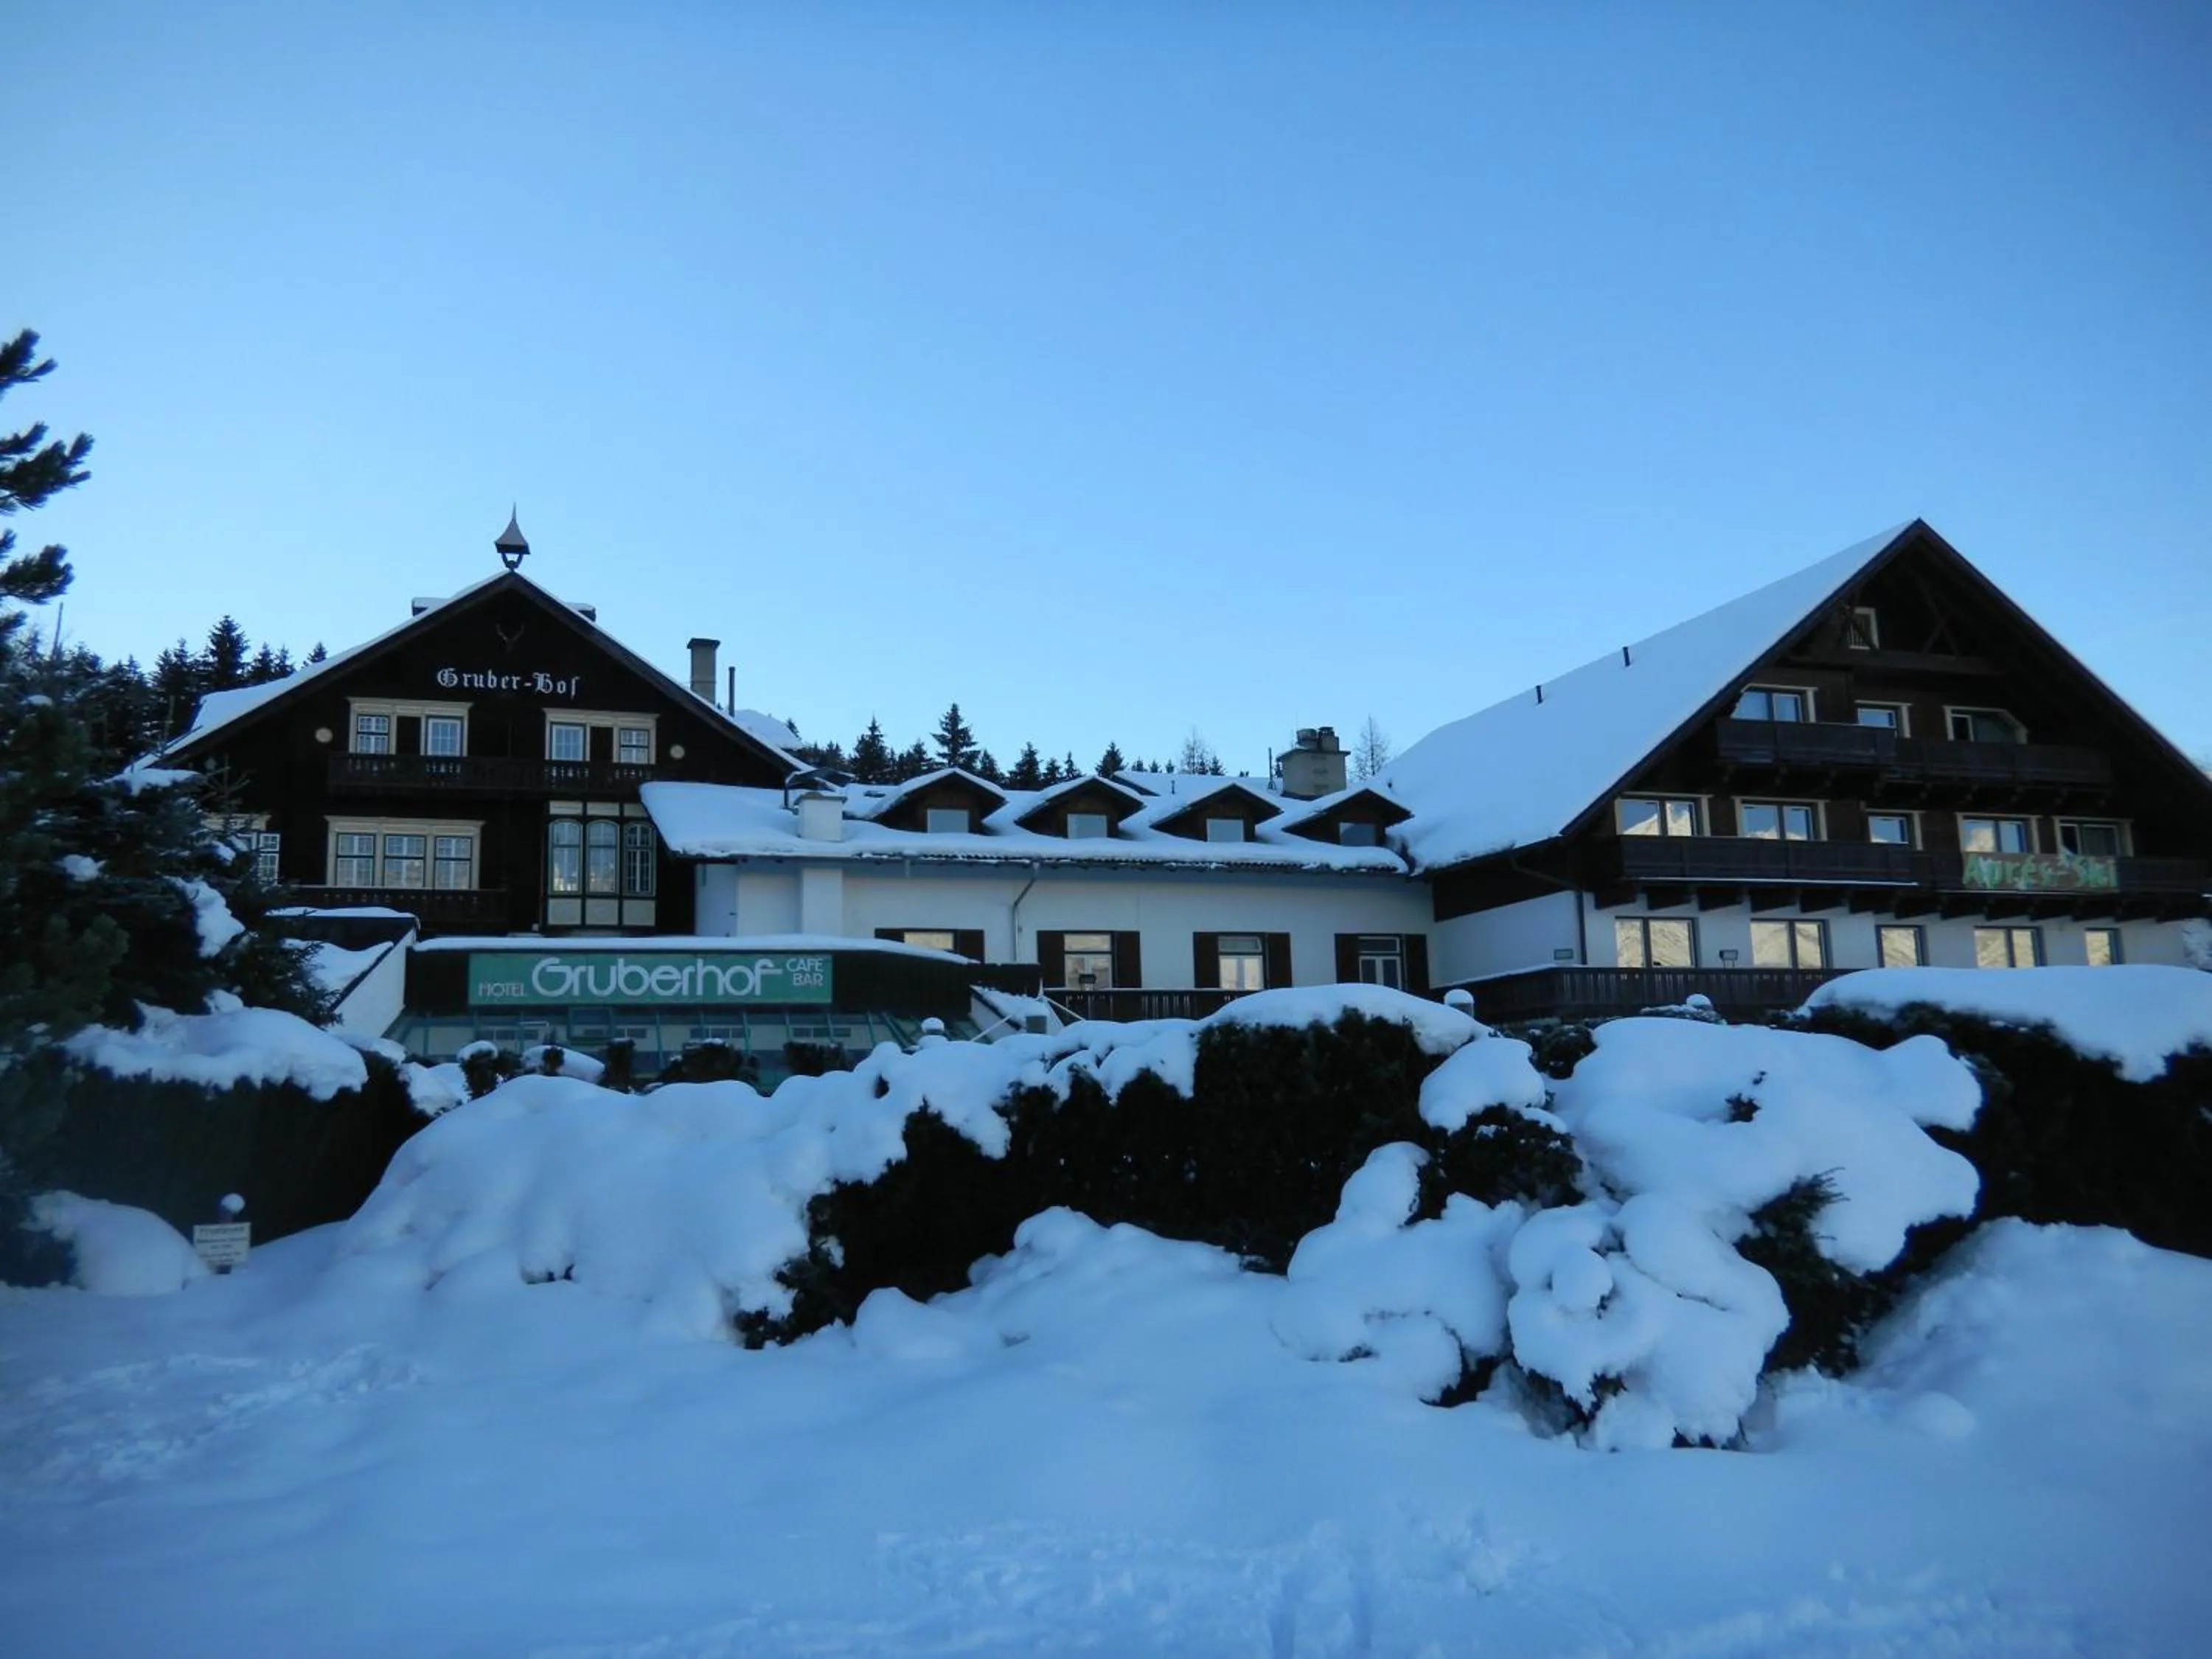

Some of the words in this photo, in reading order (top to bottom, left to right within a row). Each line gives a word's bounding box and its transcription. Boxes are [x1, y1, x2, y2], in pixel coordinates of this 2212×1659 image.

[479, 983, 527, 998] HOTEL
[532, 958, 782, 996] Gruberhof
[793, 973, 824, 987] BAR
